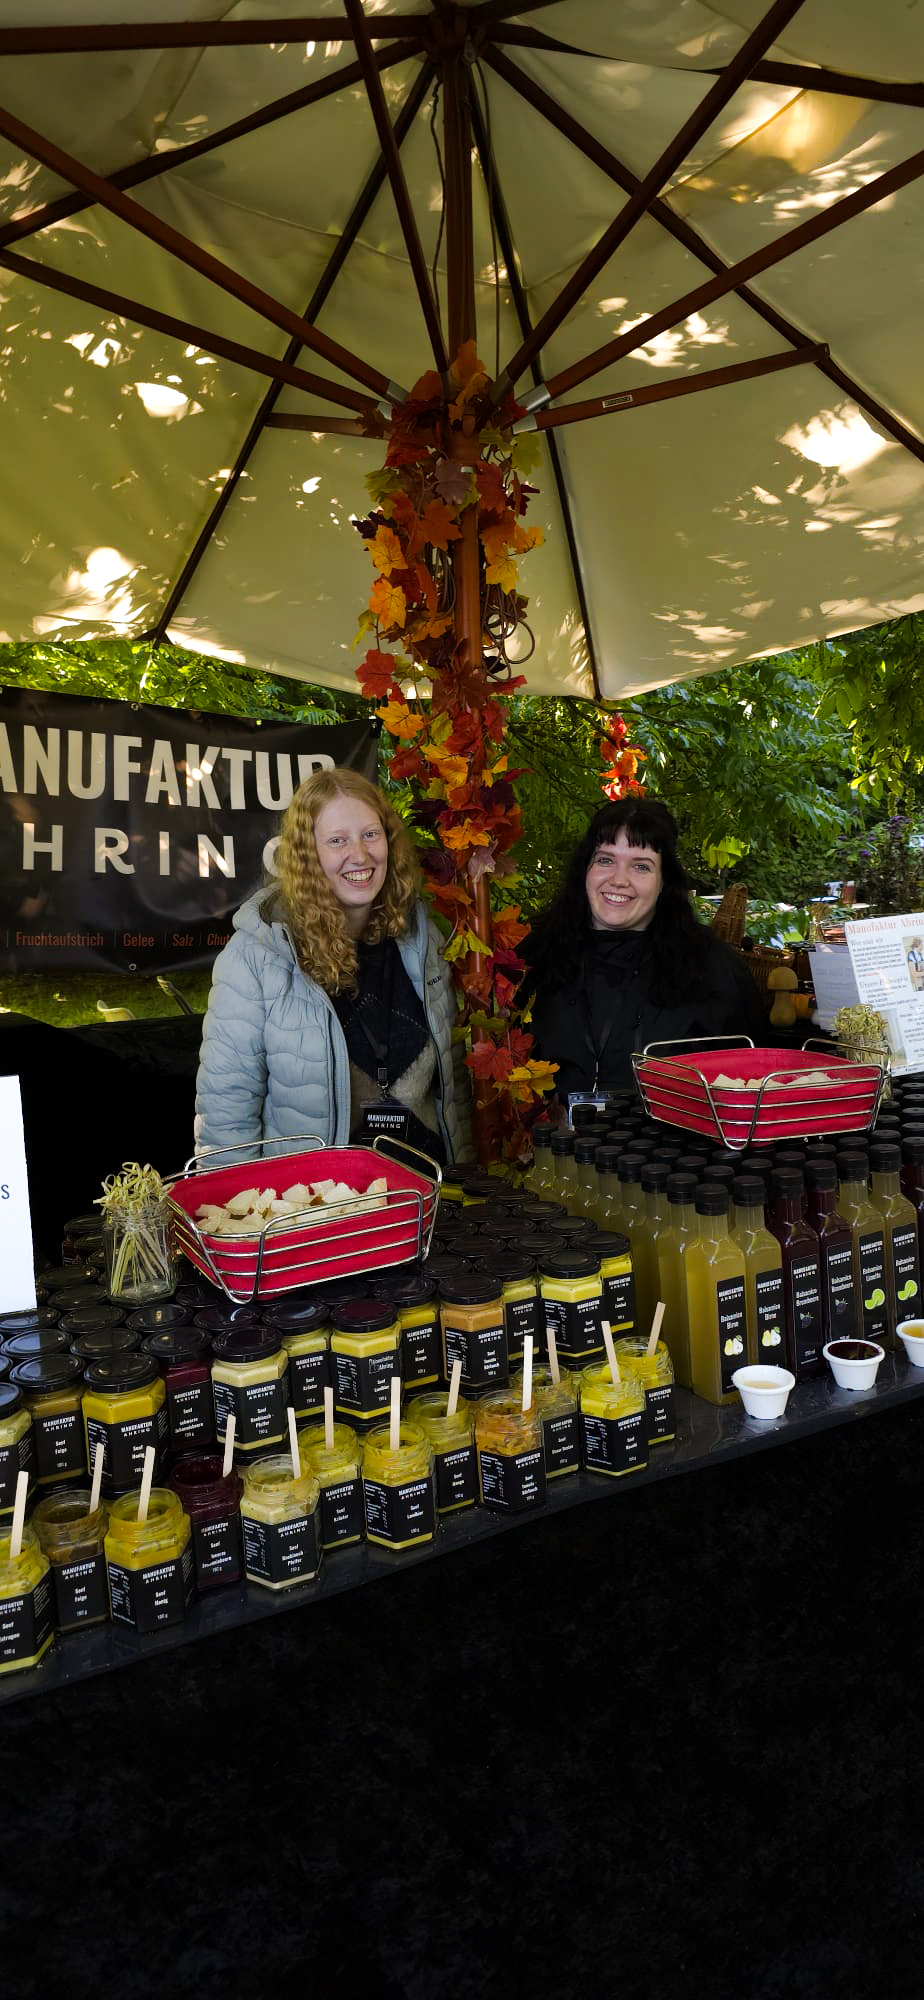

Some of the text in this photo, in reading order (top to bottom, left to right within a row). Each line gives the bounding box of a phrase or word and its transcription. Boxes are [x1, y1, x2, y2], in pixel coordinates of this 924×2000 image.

[848, 921, 897, 934] Manufaktur
[15, 931, 104, 947] Fruchtaufstrich
[123, 932, 155, 947] Gelee
[172, 932, 193, 947] Salz
[367, 1114, 405, 1122] MANUFAKTUR
[121, 1421, 152, 1433] MANUFAKTUR
[278, 1520, 308, 1533] MANUFAKTUR
[62, 1561, 96, 1576] MANUFAKTUR
[143, 1565, 175, 1580] MANUFAKTUR
[75, 1586, 86, 1594] Senf
[156, 1589, 166, 1598] Senf
[2, 1621, 14, 1630] Senf
[0, 1633, 20, 1642] stragon
